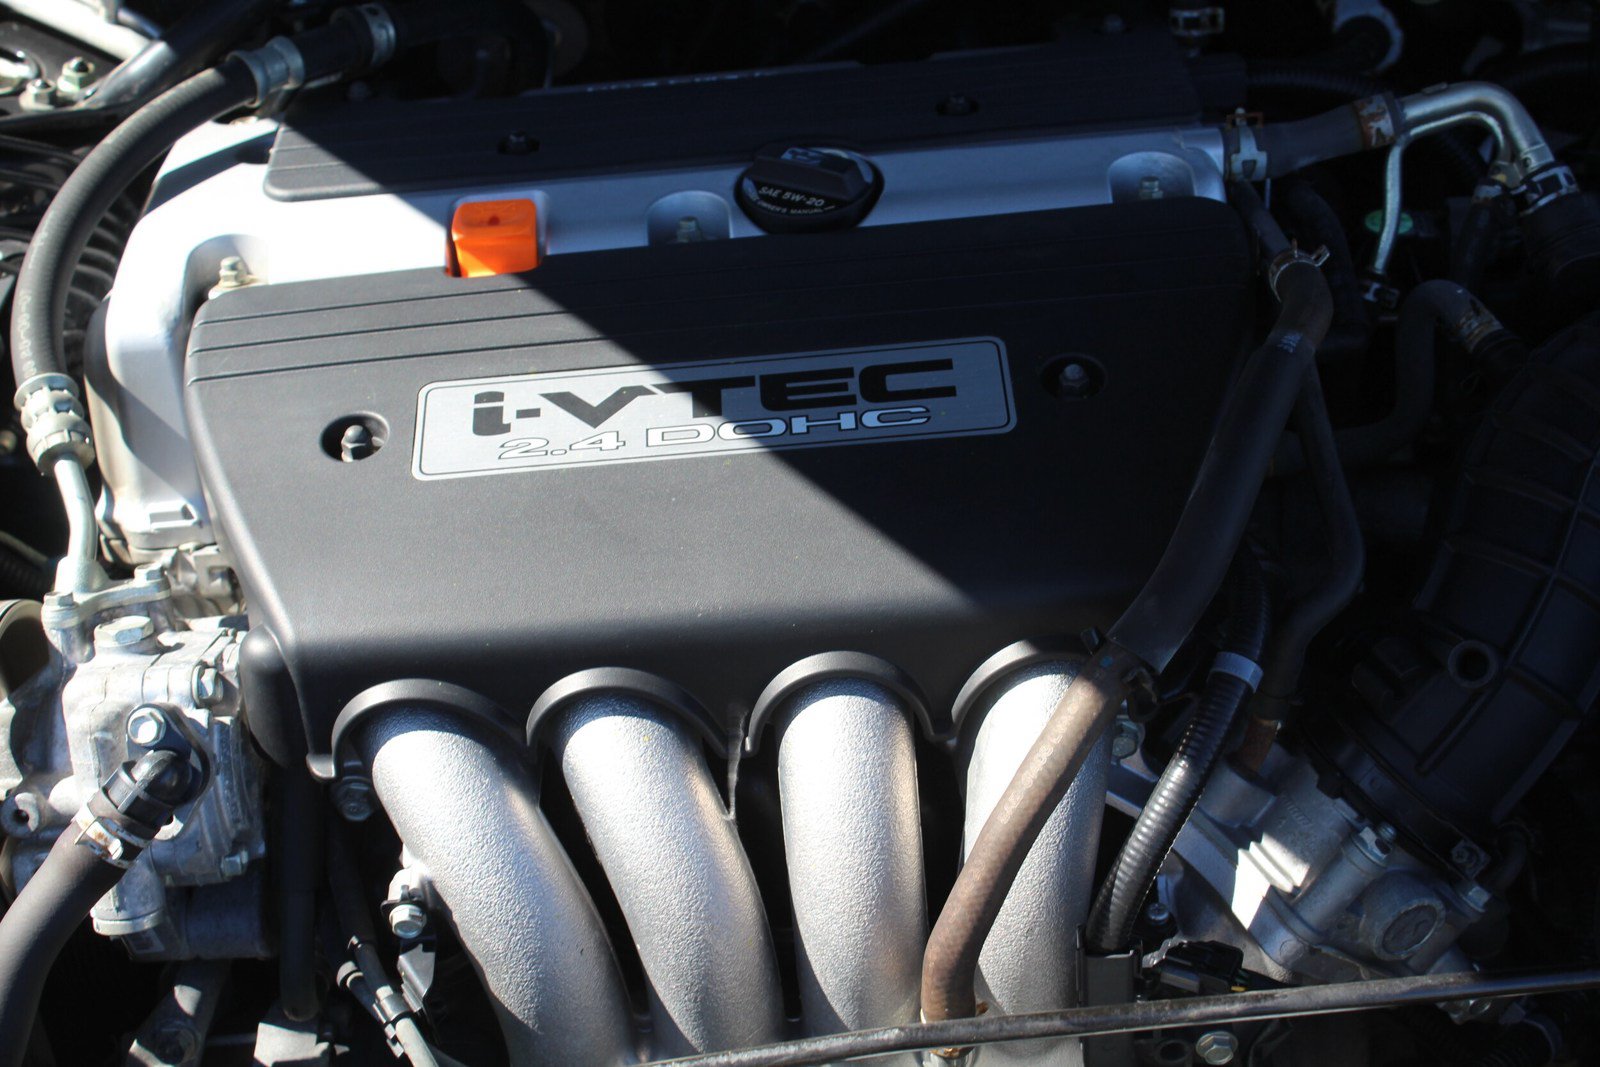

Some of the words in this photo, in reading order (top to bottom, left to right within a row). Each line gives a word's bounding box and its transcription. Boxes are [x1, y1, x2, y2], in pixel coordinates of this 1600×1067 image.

[758, 186, 780, 198] SAE
[782, 192, 824, 206] 5W-20
[472, 358, 957, 437] i-VTEC
[498, 430, 626, 460] 2.4
[645, 406, 930, 448] DOHC
